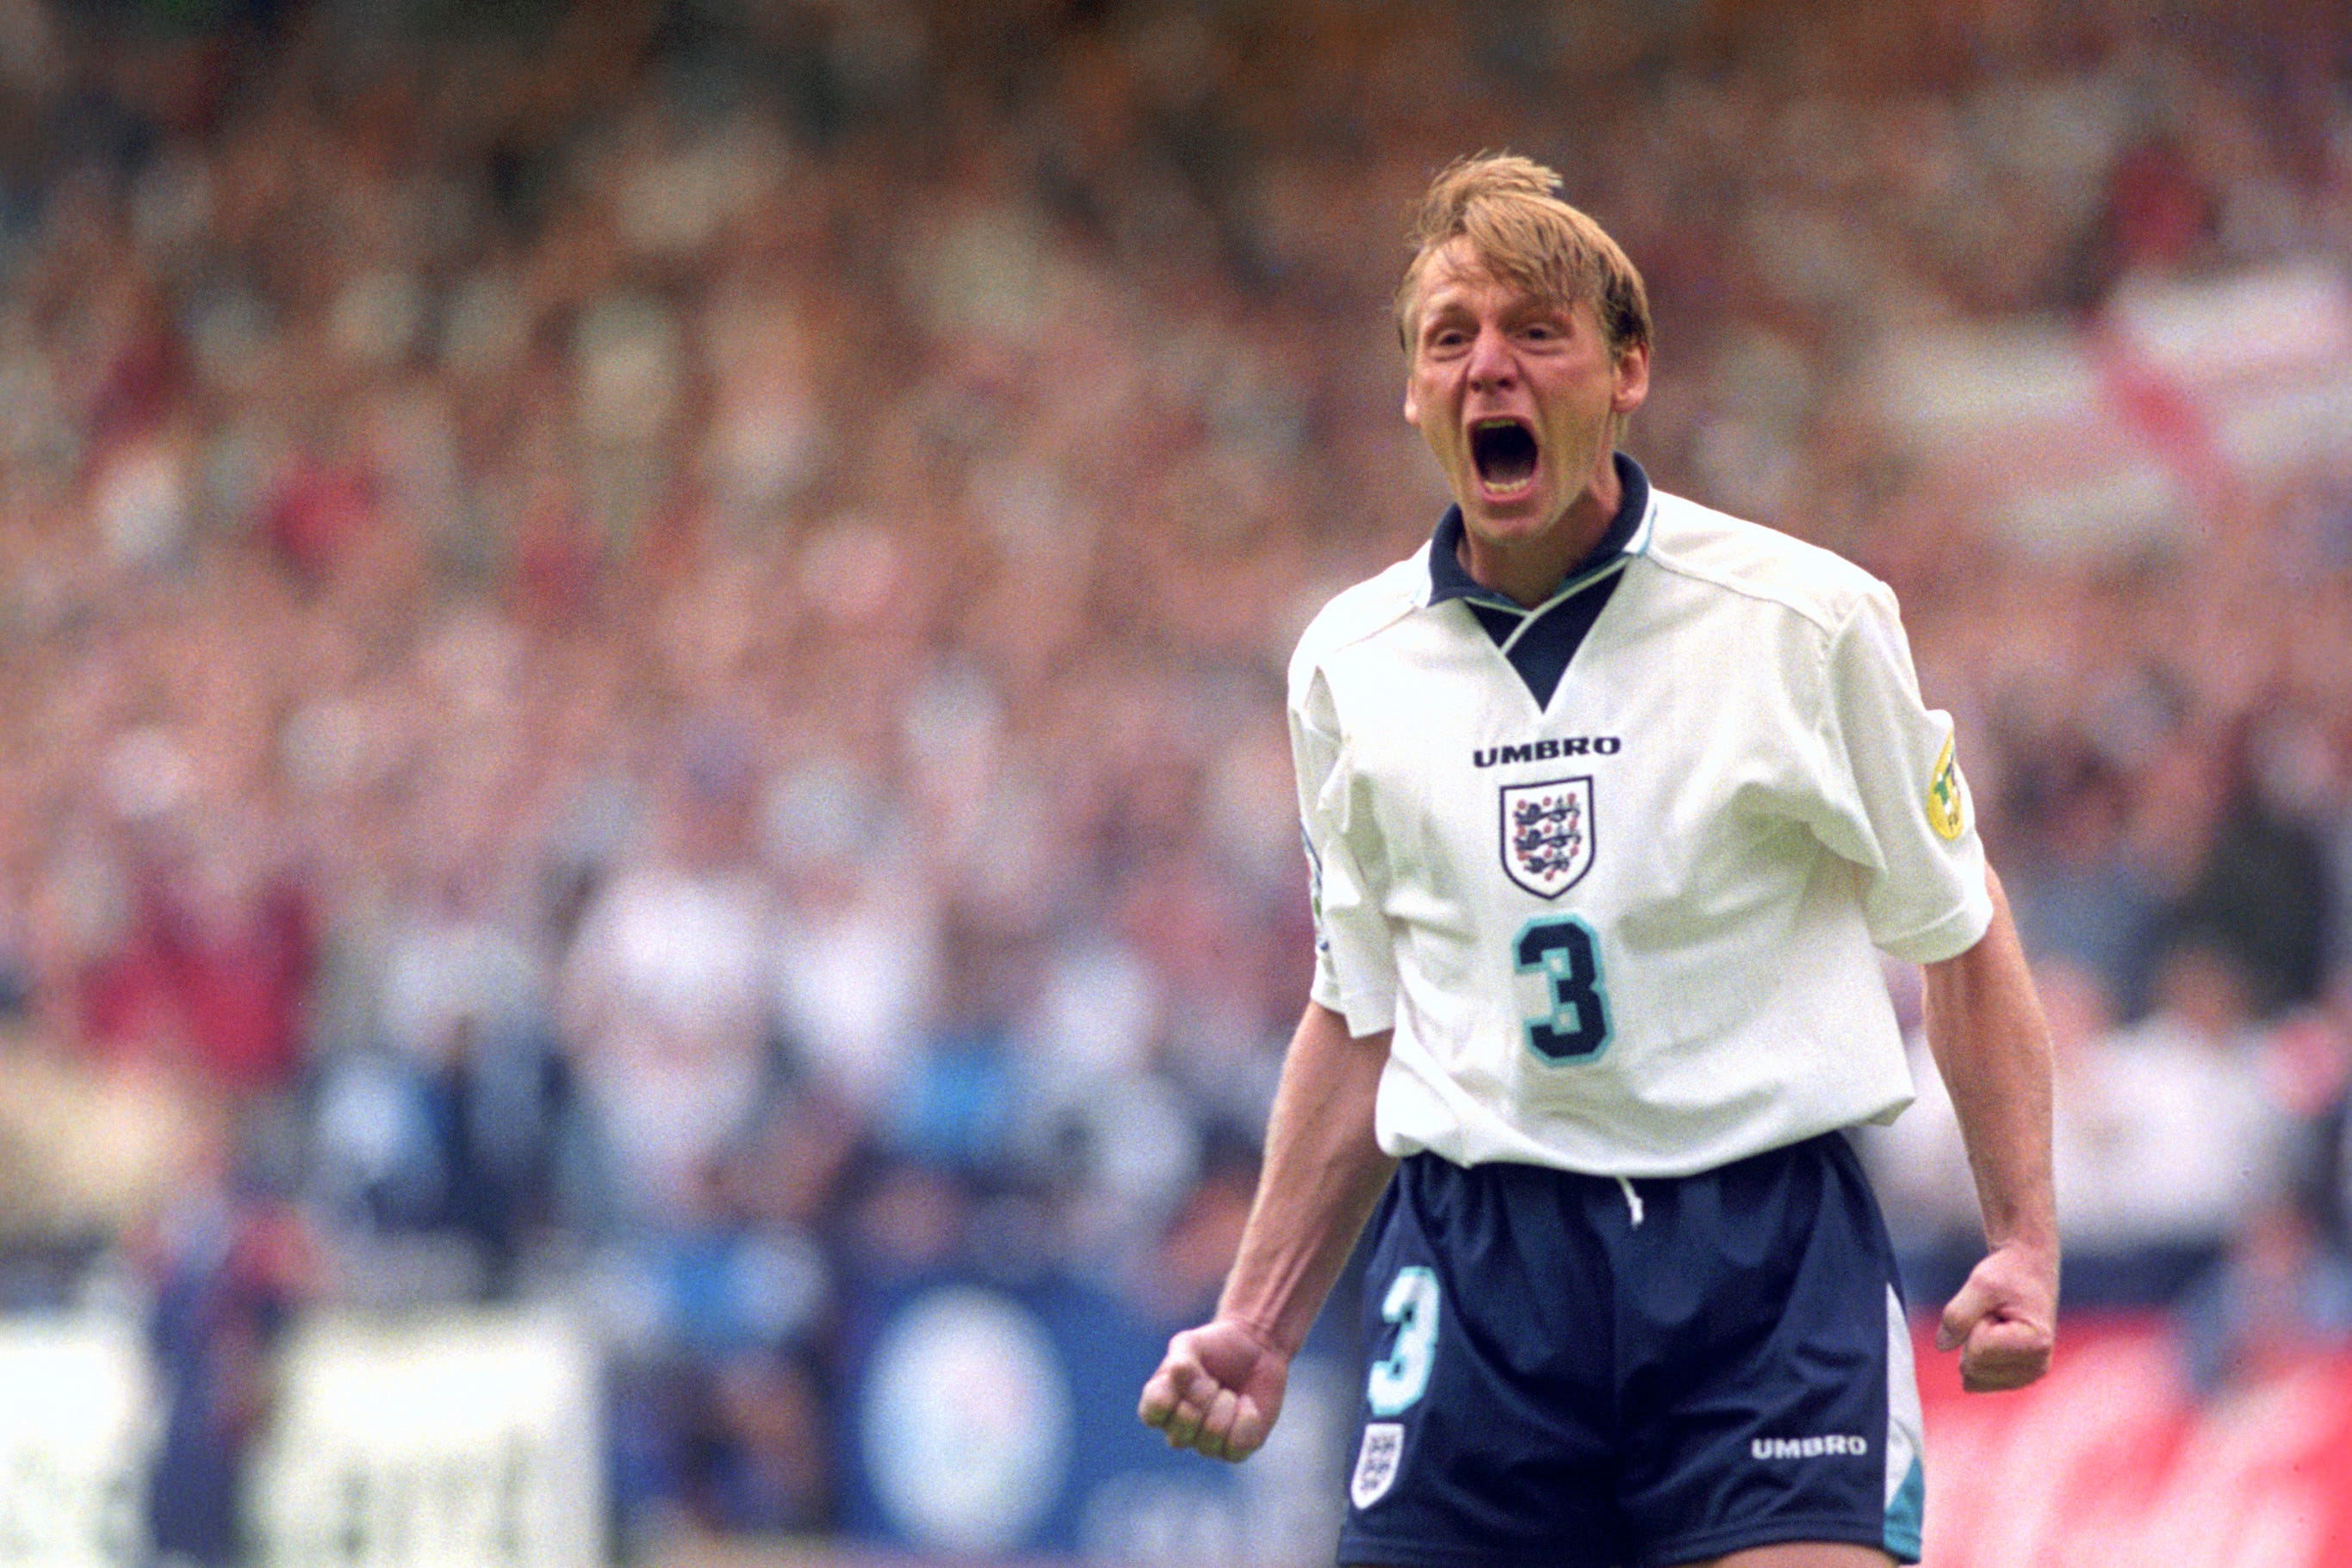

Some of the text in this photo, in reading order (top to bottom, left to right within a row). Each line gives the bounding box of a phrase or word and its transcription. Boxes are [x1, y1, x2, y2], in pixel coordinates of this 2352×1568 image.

[1473, 736, 1622, 768] UMBRO
[1512, 914, 1614, 1066] 3
[1367, 1266, 1441, 1416] 3
[1751, 1435, 1868, 1460] UMBRO
